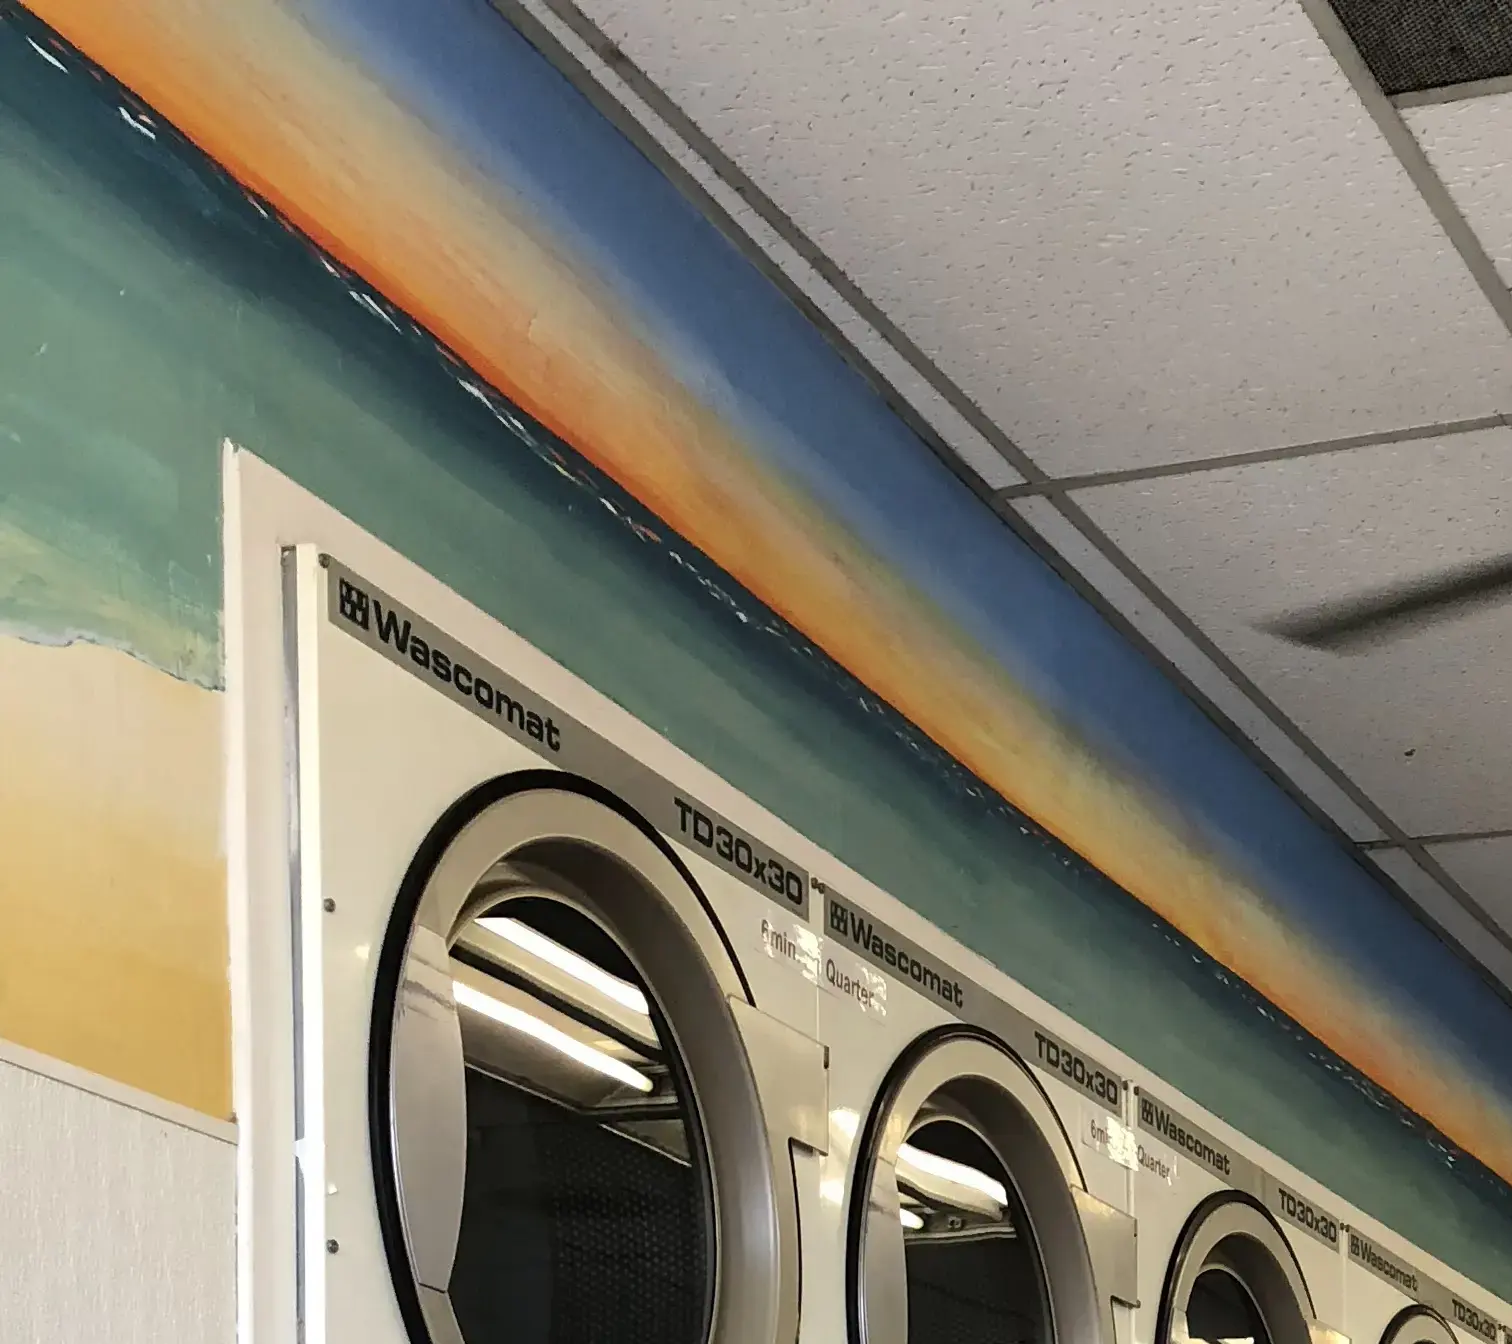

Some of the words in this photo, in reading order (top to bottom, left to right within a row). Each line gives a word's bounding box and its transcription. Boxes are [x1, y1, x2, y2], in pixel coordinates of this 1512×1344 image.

[372, 600, 561, 752] Wascomat
[673, 797, 803, 906] TD30x30
[850, 912, 963, 1009] Wascomat
[1034, 1030, 1118, 1106] TD30x30
[1154, 1105, 1231, 1176] Wascomat
[1278, 1187, 1337, 1243] TD30x30
[1359, 1239, 1418, 1292] Wascomat
[1451, 1299, 1496, 1342] TD30x30
